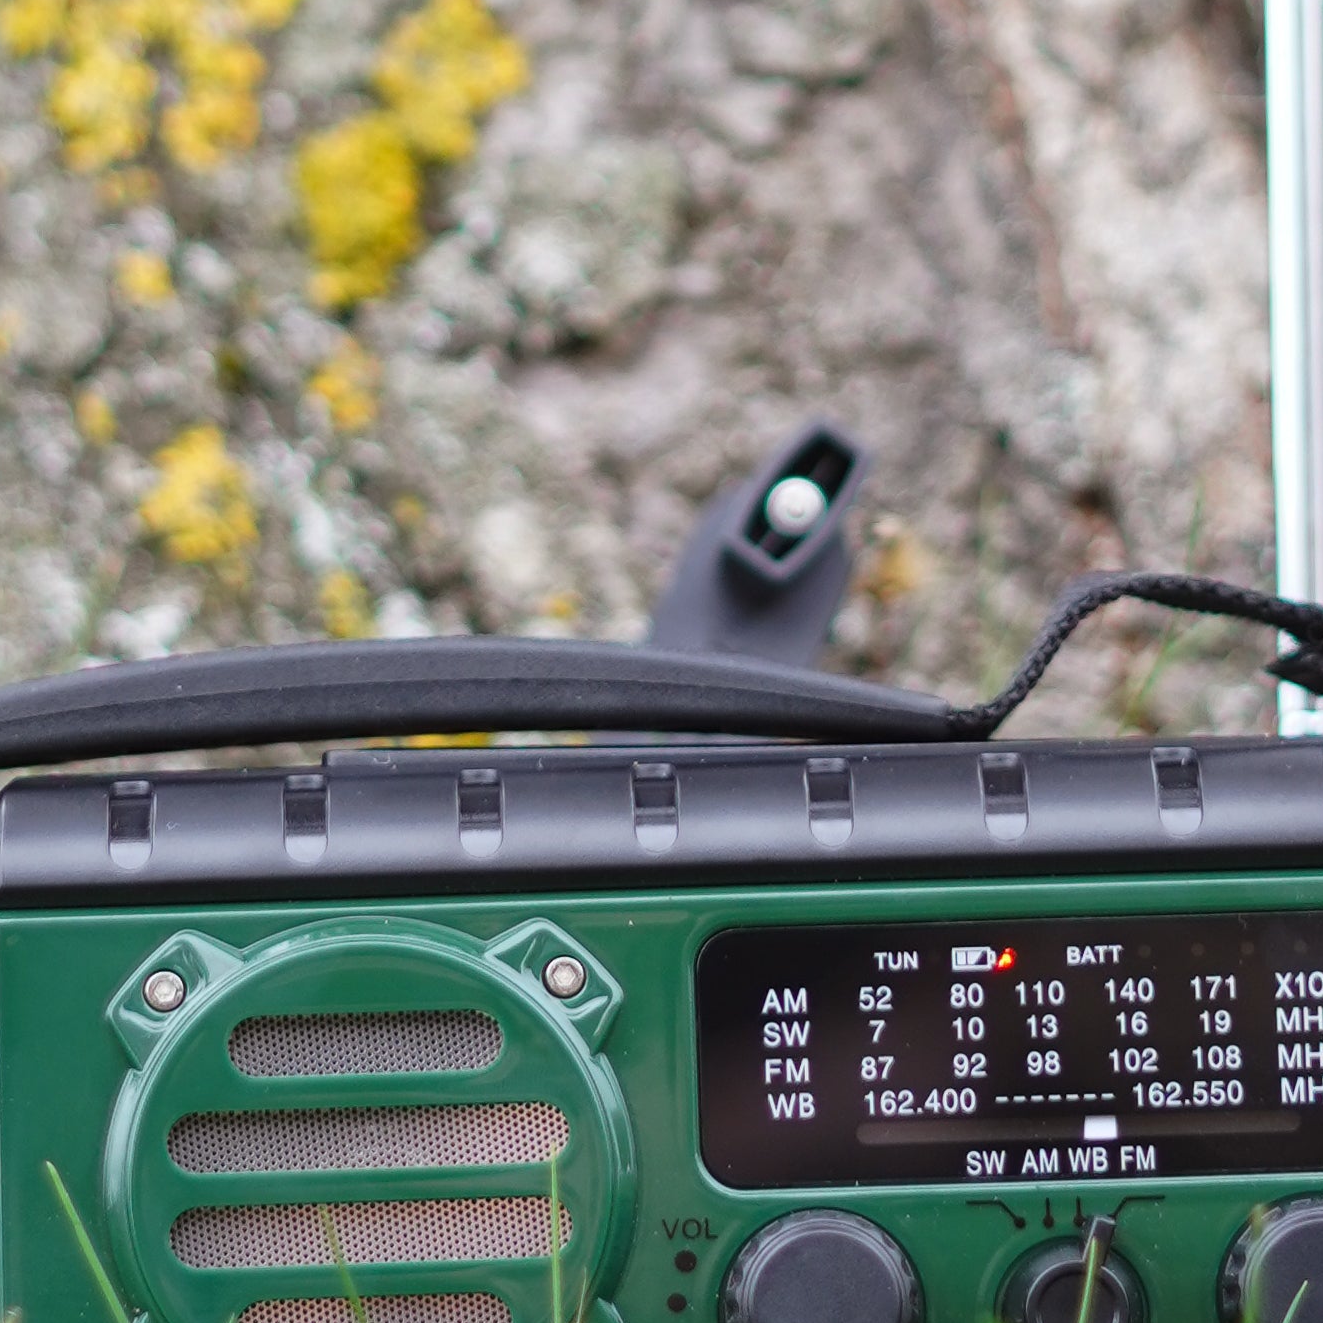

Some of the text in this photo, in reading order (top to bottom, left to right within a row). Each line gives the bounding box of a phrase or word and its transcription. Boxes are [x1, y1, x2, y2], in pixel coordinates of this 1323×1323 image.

[873, 950, 919, 971] TUN
[1066, 944, 1124, 967] BATT
[761, 987, 808, 1015] AM
[858, 985, 893, 1012] 52
[949, 982, 985, 1009] 80
[1014, 979, 1066, 1006] 110
[1104, 977, 1155, 1004] 140
[1190, 974, 1237, 1001] 171
[763, 1020, 811, 1049] SW
[868, 1019, 886, 1044] 7
[952, 1016, 985, 1042] 10
[1026, 1013, 1059, 1040] 13
[1115, 1010, 1149, 1036] 16
[1199, 1009, 1232, 1035] 19
[764, 1057, 811, 1085] FM
[860, 1055, 896, 1082] 87
[952, 1052, 988, 1079] 92
[1026, 1050, 1062, 1076] 98
[1108, 1047, 1159, 1073] 102
[1192, 1044, 1242, 1071] 108
[767, 1092, 816, 1120] WB
[863, 1087, 977, 1117] 162.400
[1132, 1079, 1244, 1108] 162.550
[966, 1144, 1156, 1177] SW AM WB FM
[661, 1217, 719, 1240] VOL
